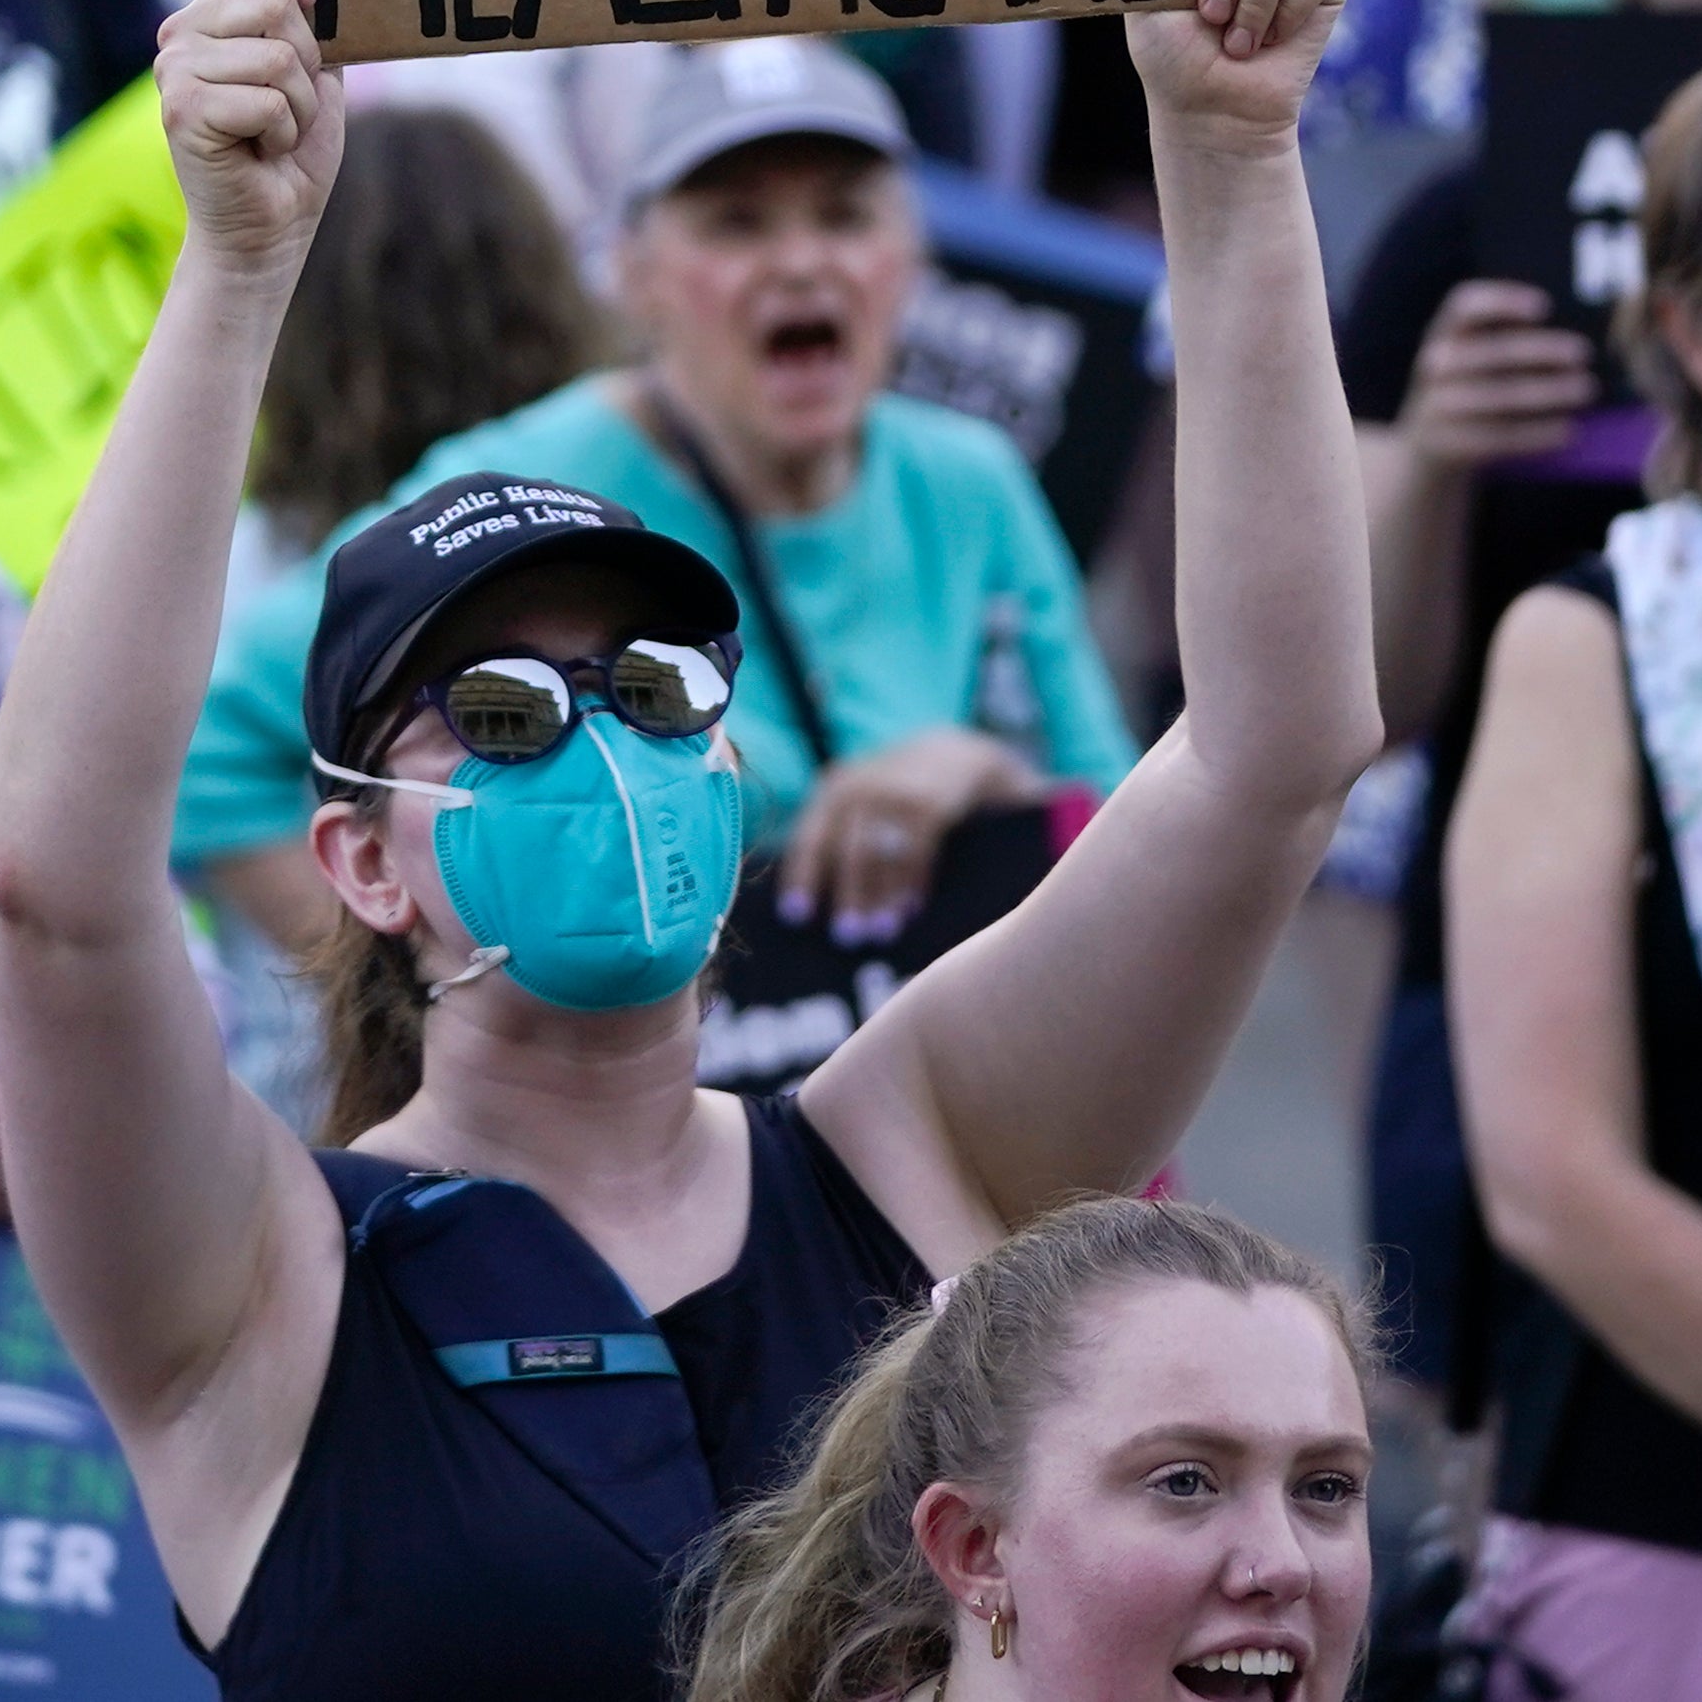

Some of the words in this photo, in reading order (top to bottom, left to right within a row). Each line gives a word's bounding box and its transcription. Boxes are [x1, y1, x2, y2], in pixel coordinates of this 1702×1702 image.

[409, 490, 501, 545] Public
[502, 485, 603, 510] Health
[433, 513, 521, 557] Saves
[523, 504, 606, 528] Lives
